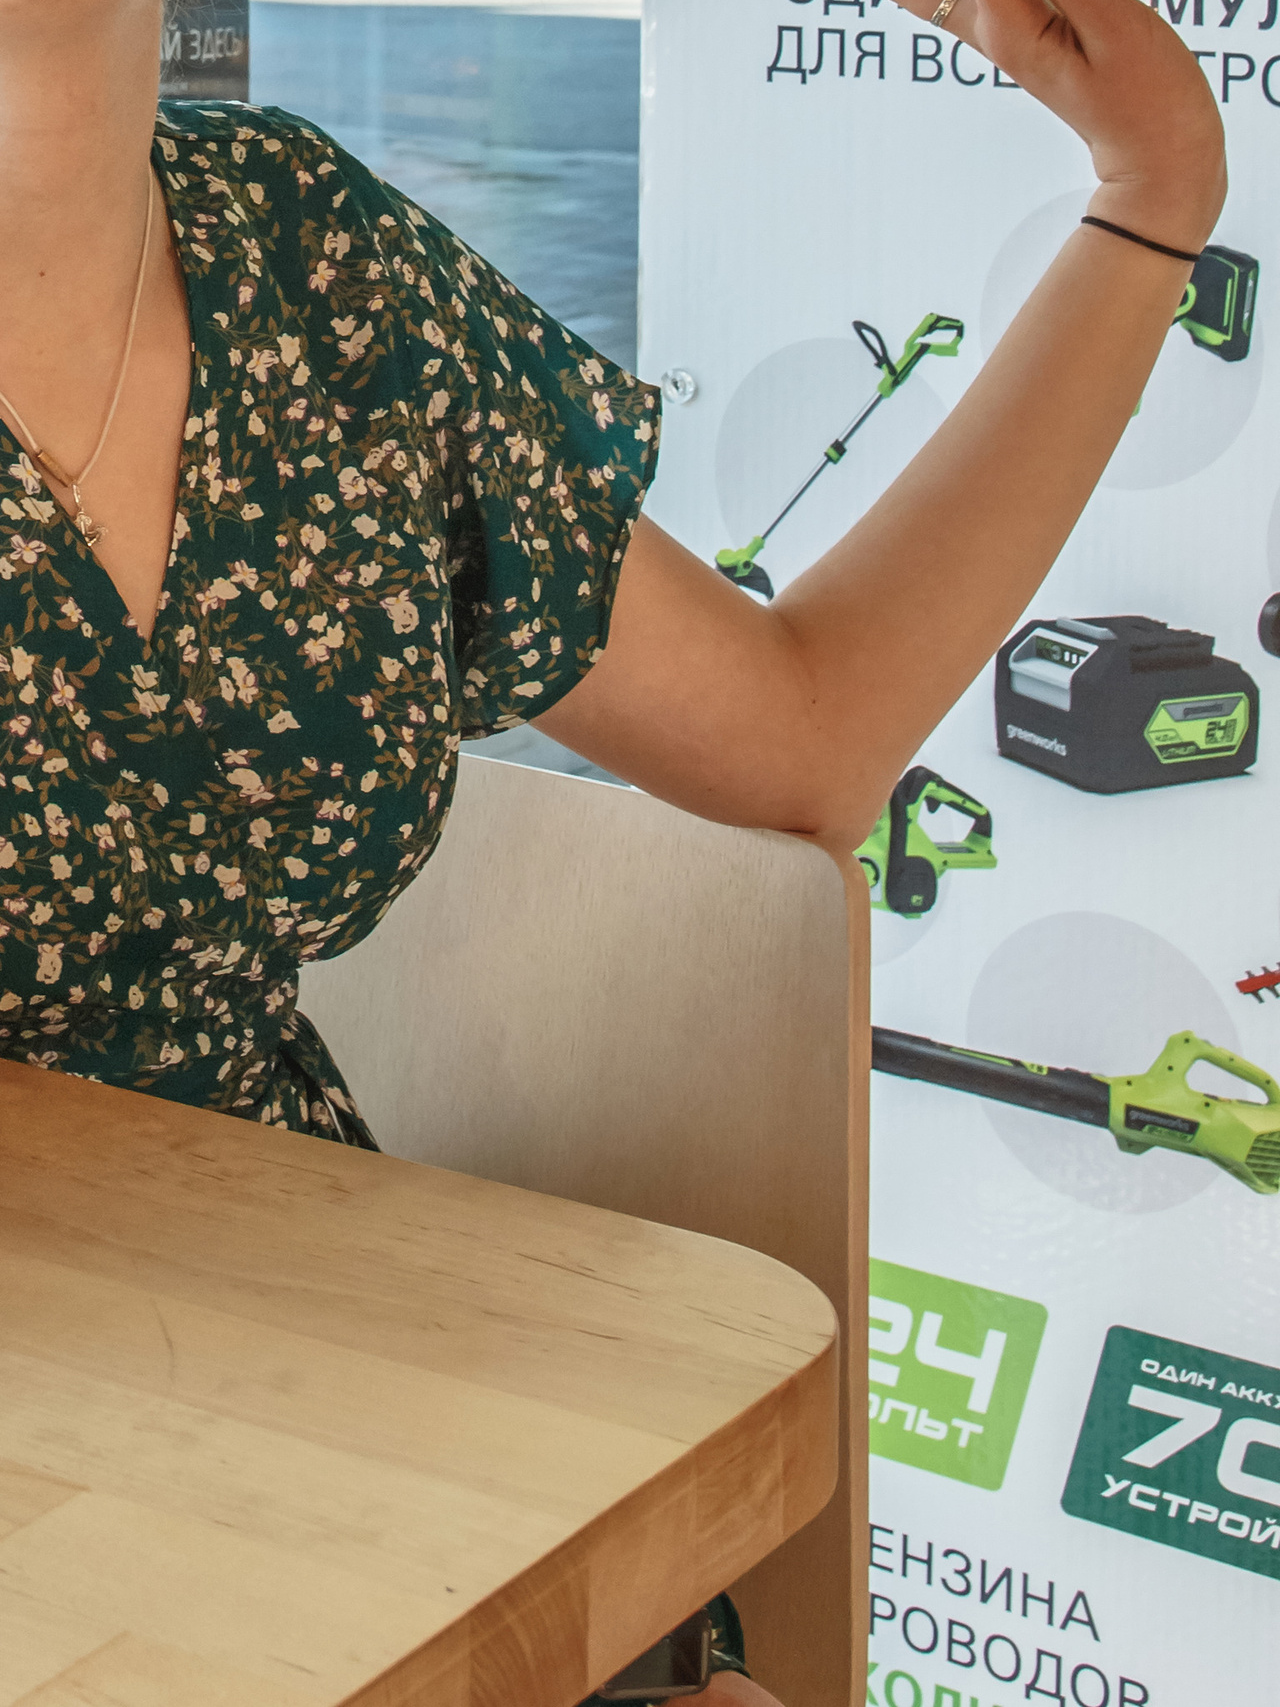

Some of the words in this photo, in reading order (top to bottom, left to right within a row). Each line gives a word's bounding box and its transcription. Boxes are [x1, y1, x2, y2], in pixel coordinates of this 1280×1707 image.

[766, 25, 886, 85] ДЛЯ
[1140, 1358, 1216, 1390] ОДИН
[1100, 1473, 1280, 1549] УСТРОЙ
